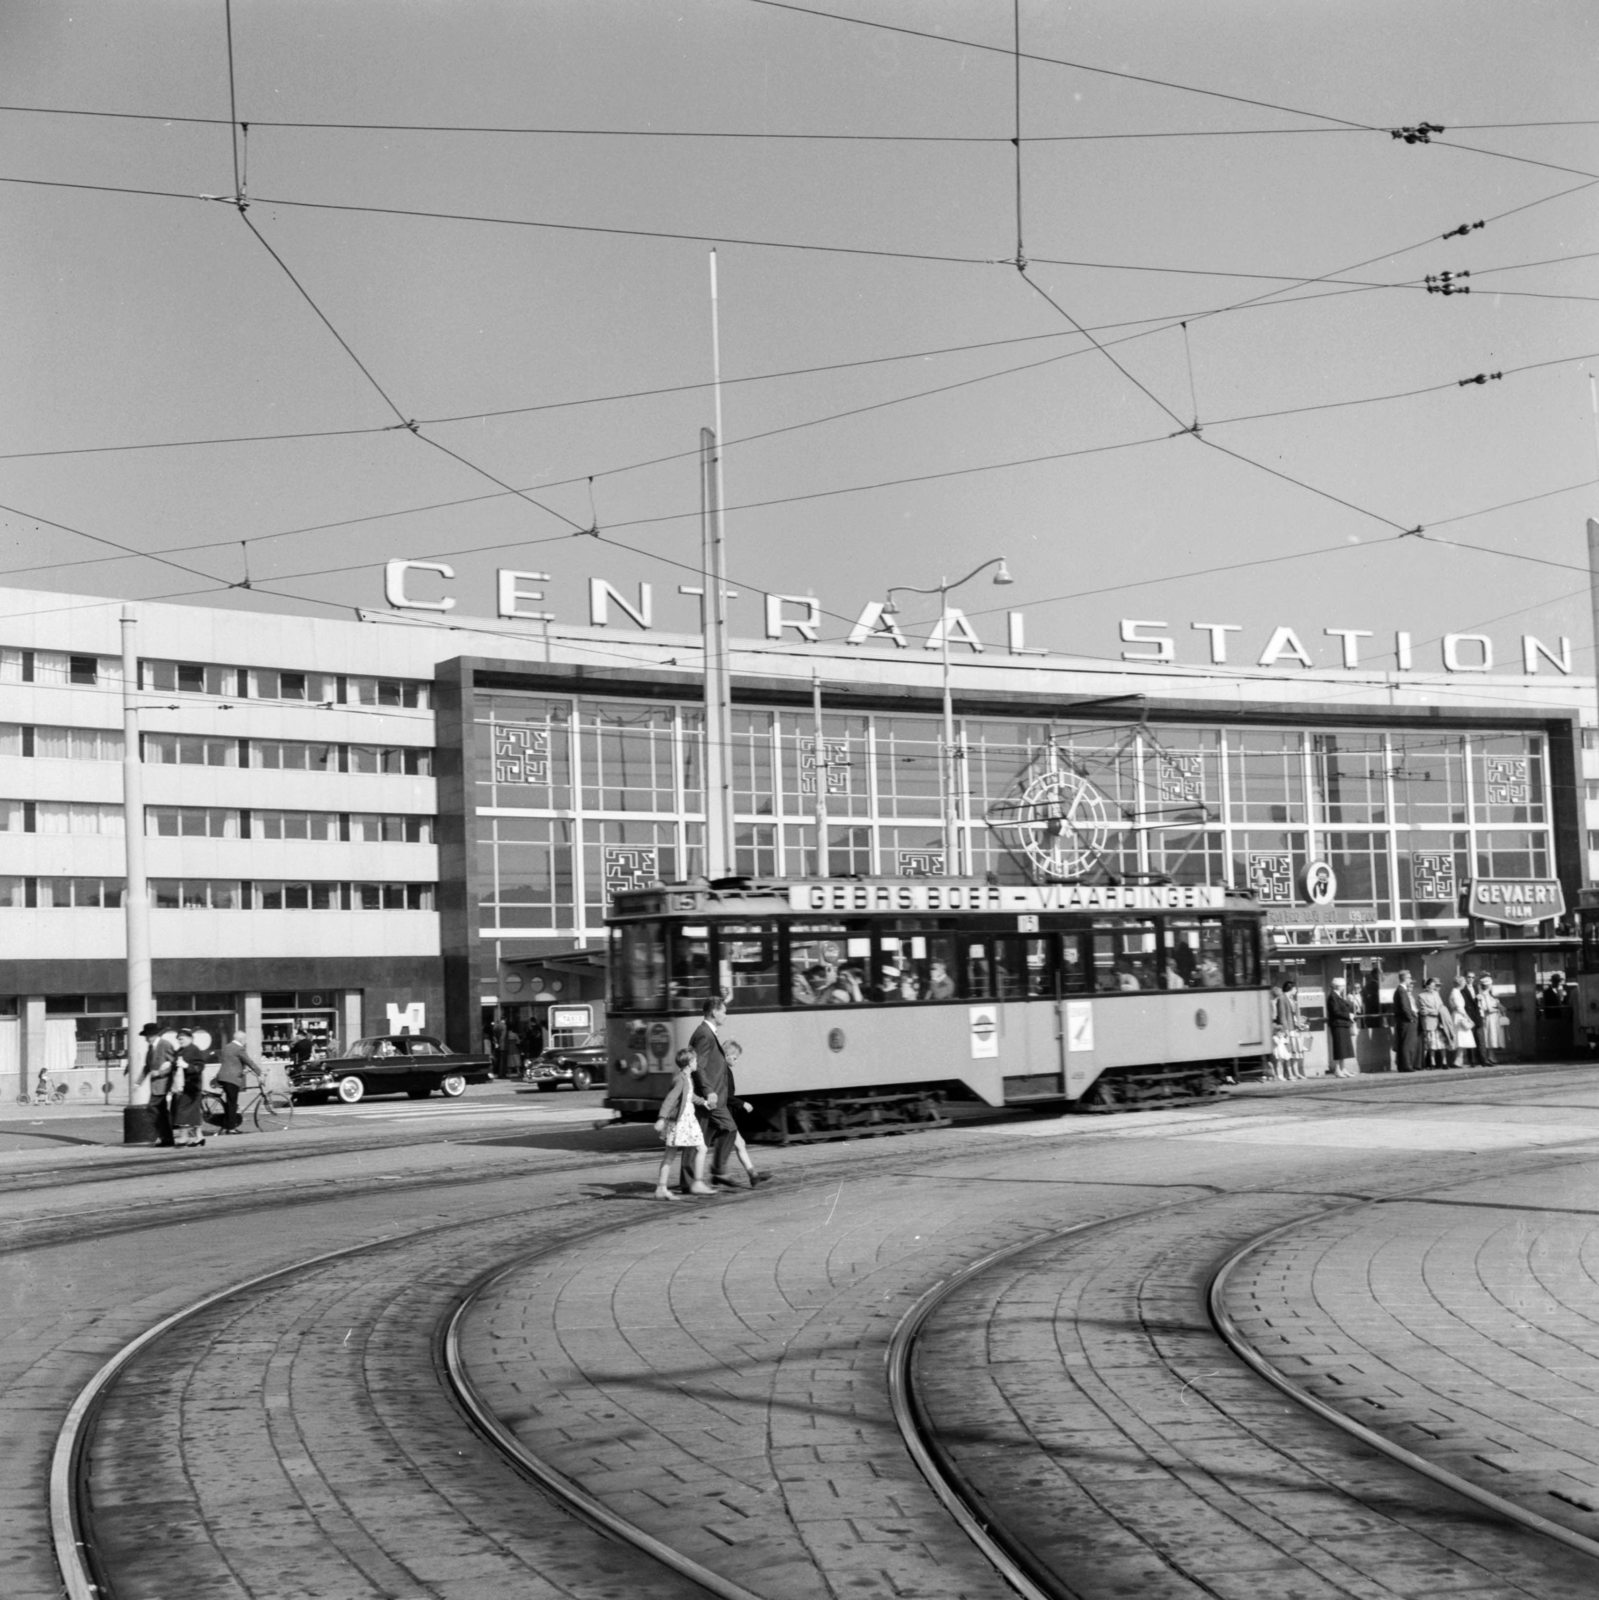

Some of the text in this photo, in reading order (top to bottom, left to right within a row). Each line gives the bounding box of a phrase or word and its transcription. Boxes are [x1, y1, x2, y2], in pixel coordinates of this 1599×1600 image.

[1119, 618, 1573, 675] STATION
[926, 887, 1000, 910] BOER
[1036, 887, 1214, 910] VLAARDINGEN
[1477, 884, 1557, 904] GEVAERT
[1504, 905, 1533, 918] FILM
